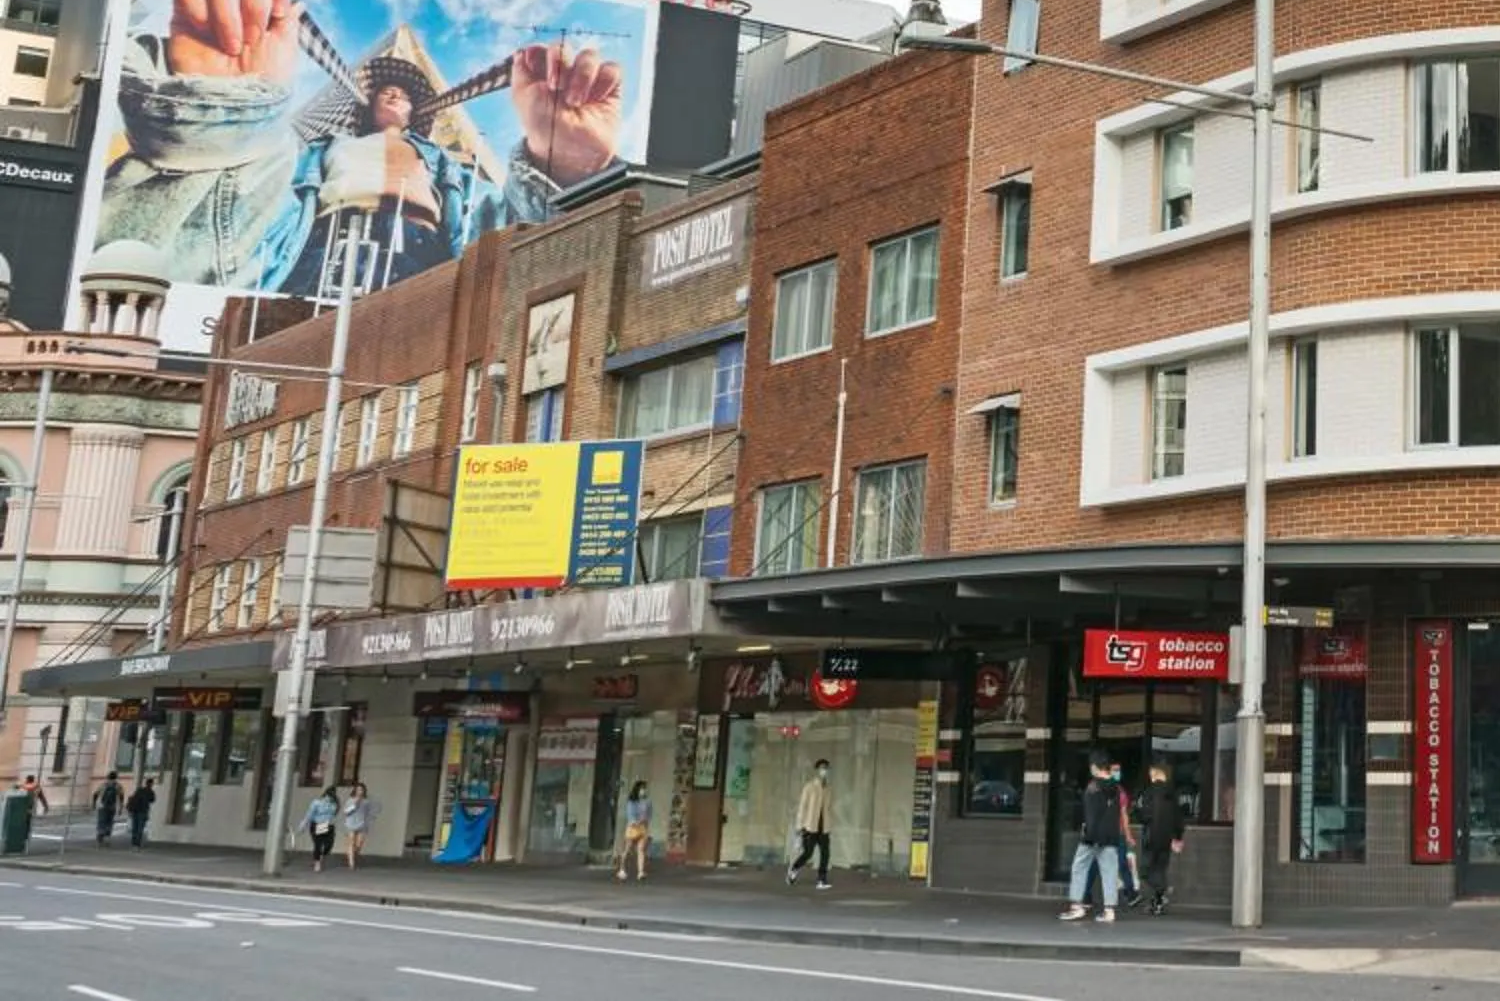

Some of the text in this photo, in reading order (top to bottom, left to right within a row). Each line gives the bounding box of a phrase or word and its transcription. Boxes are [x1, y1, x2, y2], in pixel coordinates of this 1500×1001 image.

[653, 222, 689, 274] POSH
[689, 205, 733, 259] HOTEL
[465, 457, 529, 474] for sale
[491, 614, 555, 641] 92130966
[1106, 635, 1147, 671] tsg
[1158, 637, 1225, 652] tobacco
[1157, 656, 1216, 670] station
[188, 691, 232, 707] VIP
[109, 706, 140, 719] VIP
[1428, 650, 1441, 853] TOBACCO STATION
